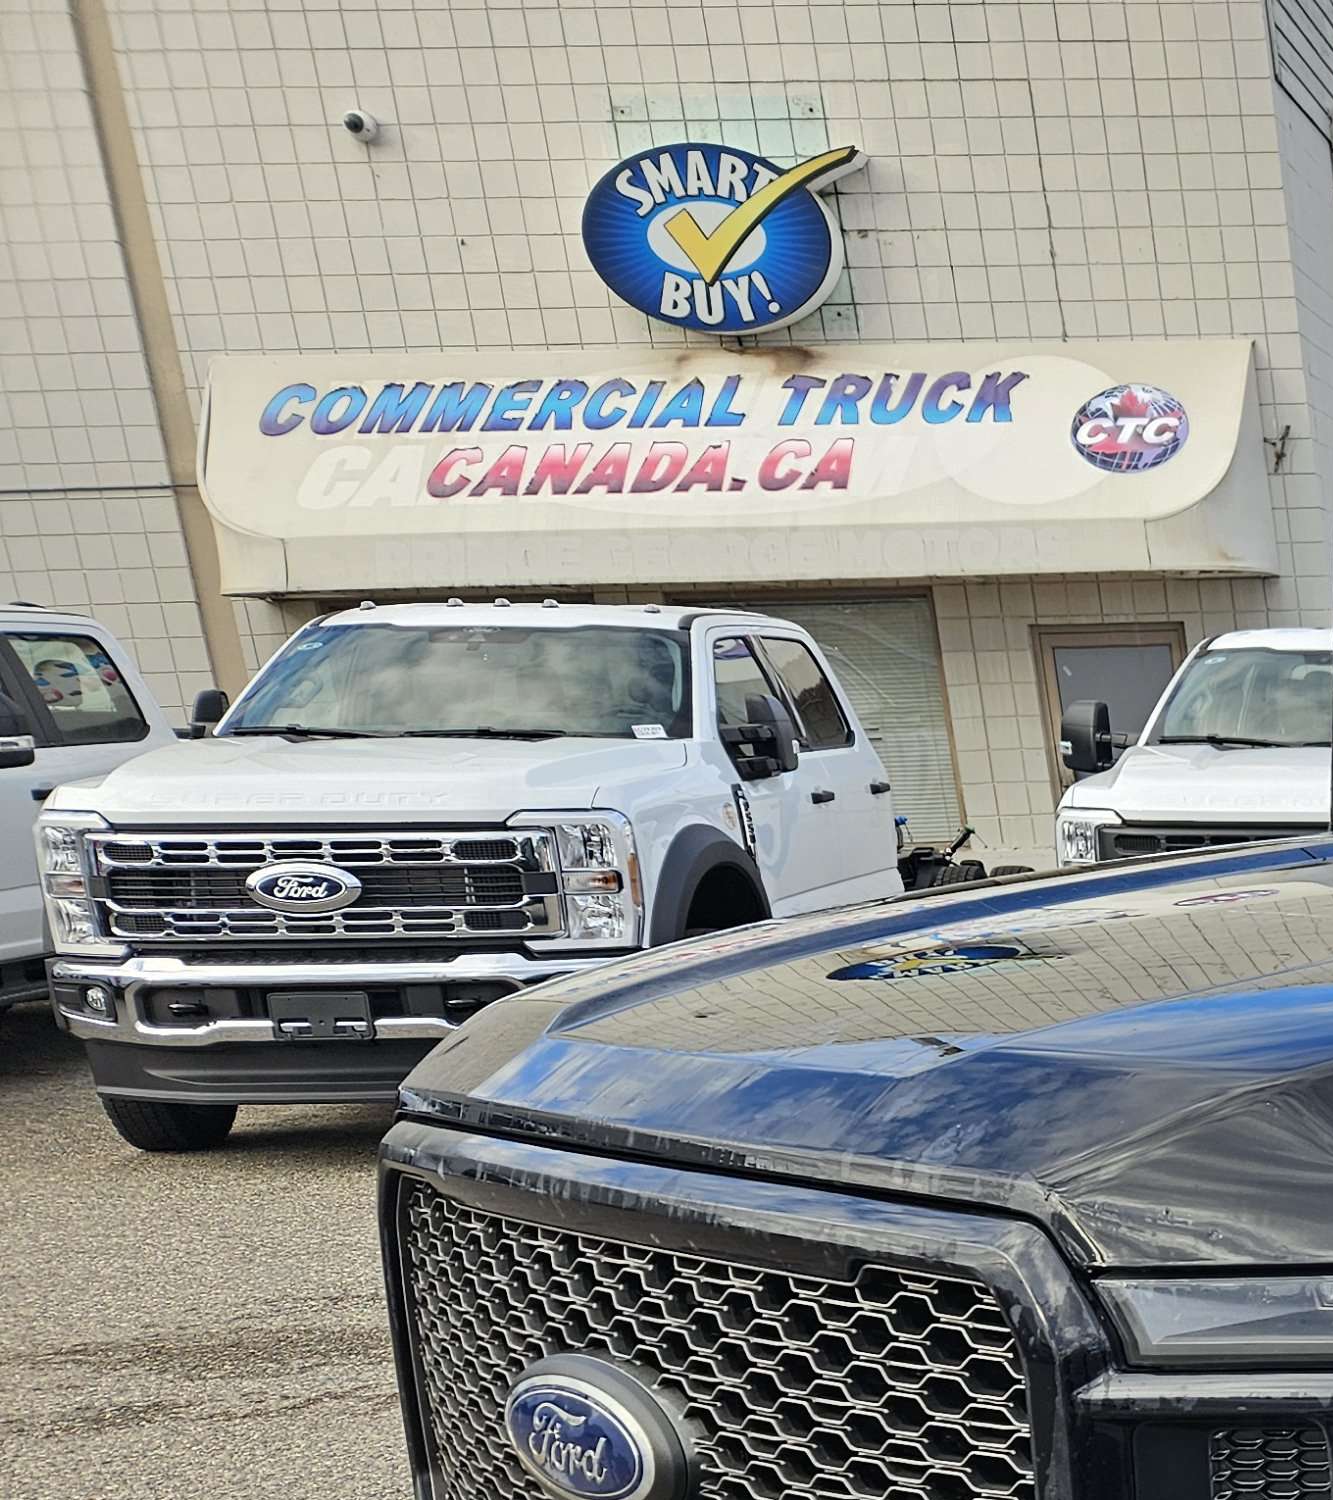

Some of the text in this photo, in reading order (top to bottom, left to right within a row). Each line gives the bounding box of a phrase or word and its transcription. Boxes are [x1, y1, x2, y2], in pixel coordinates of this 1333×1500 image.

[615, 150, 779, 217] SMART
[660, 270, 782, 325] BUY!
[258, 370, 1030, 437] COMMERCIAL TRUCK
[1076, 416, 1181, 446] CTC
[425, 437, 855, 499] CANADA.CA
[272, 875, 328, 899] Ford
[528, 1402, 608, 1485] Ford
